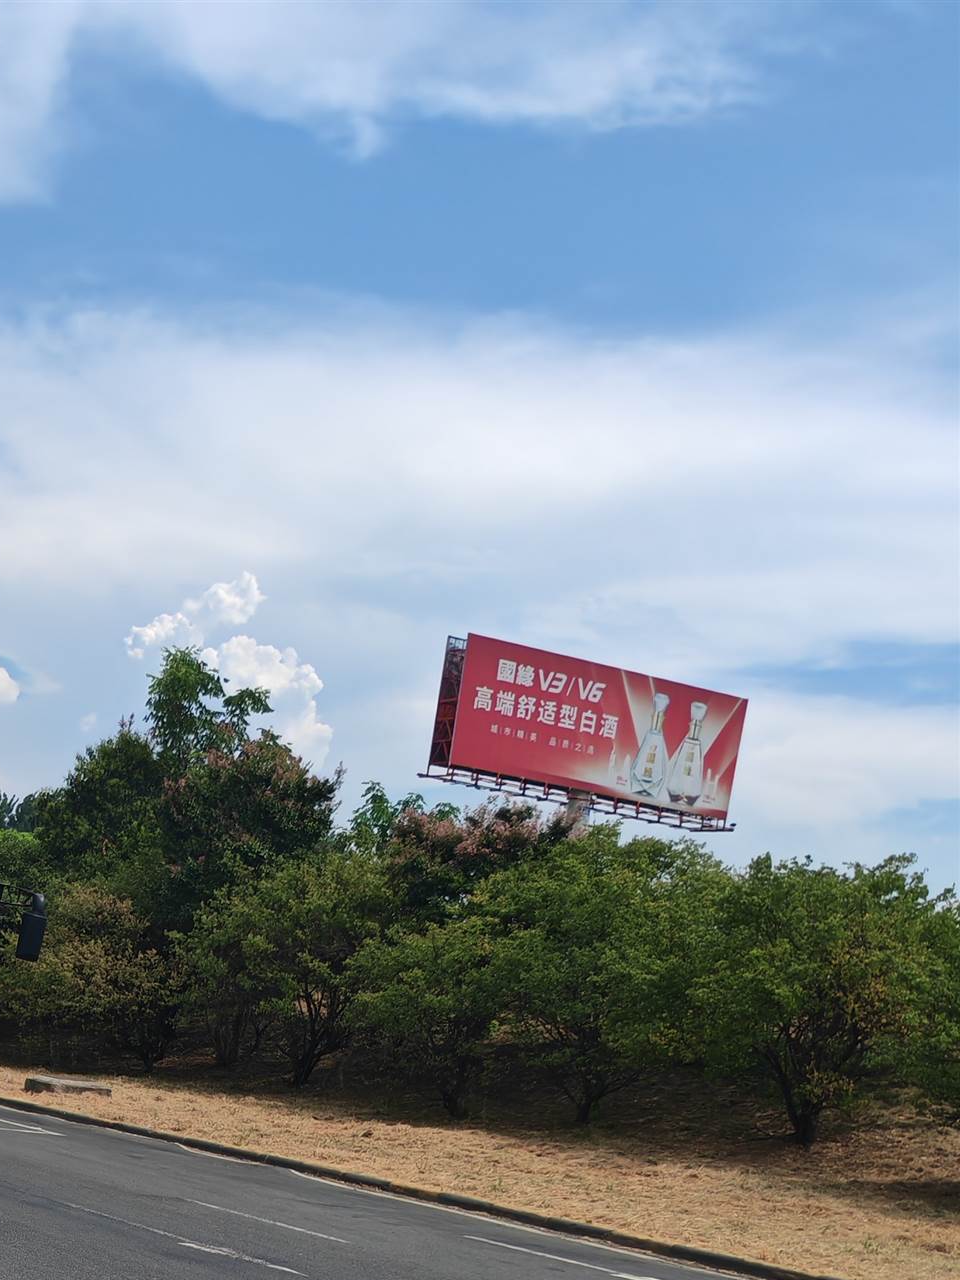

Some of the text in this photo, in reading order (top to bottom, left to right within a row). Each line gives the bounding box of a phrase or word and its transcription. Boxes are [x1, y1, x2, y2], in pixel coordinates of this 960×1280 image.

[473, 686, 620, 739] 高端舒适型白酒
